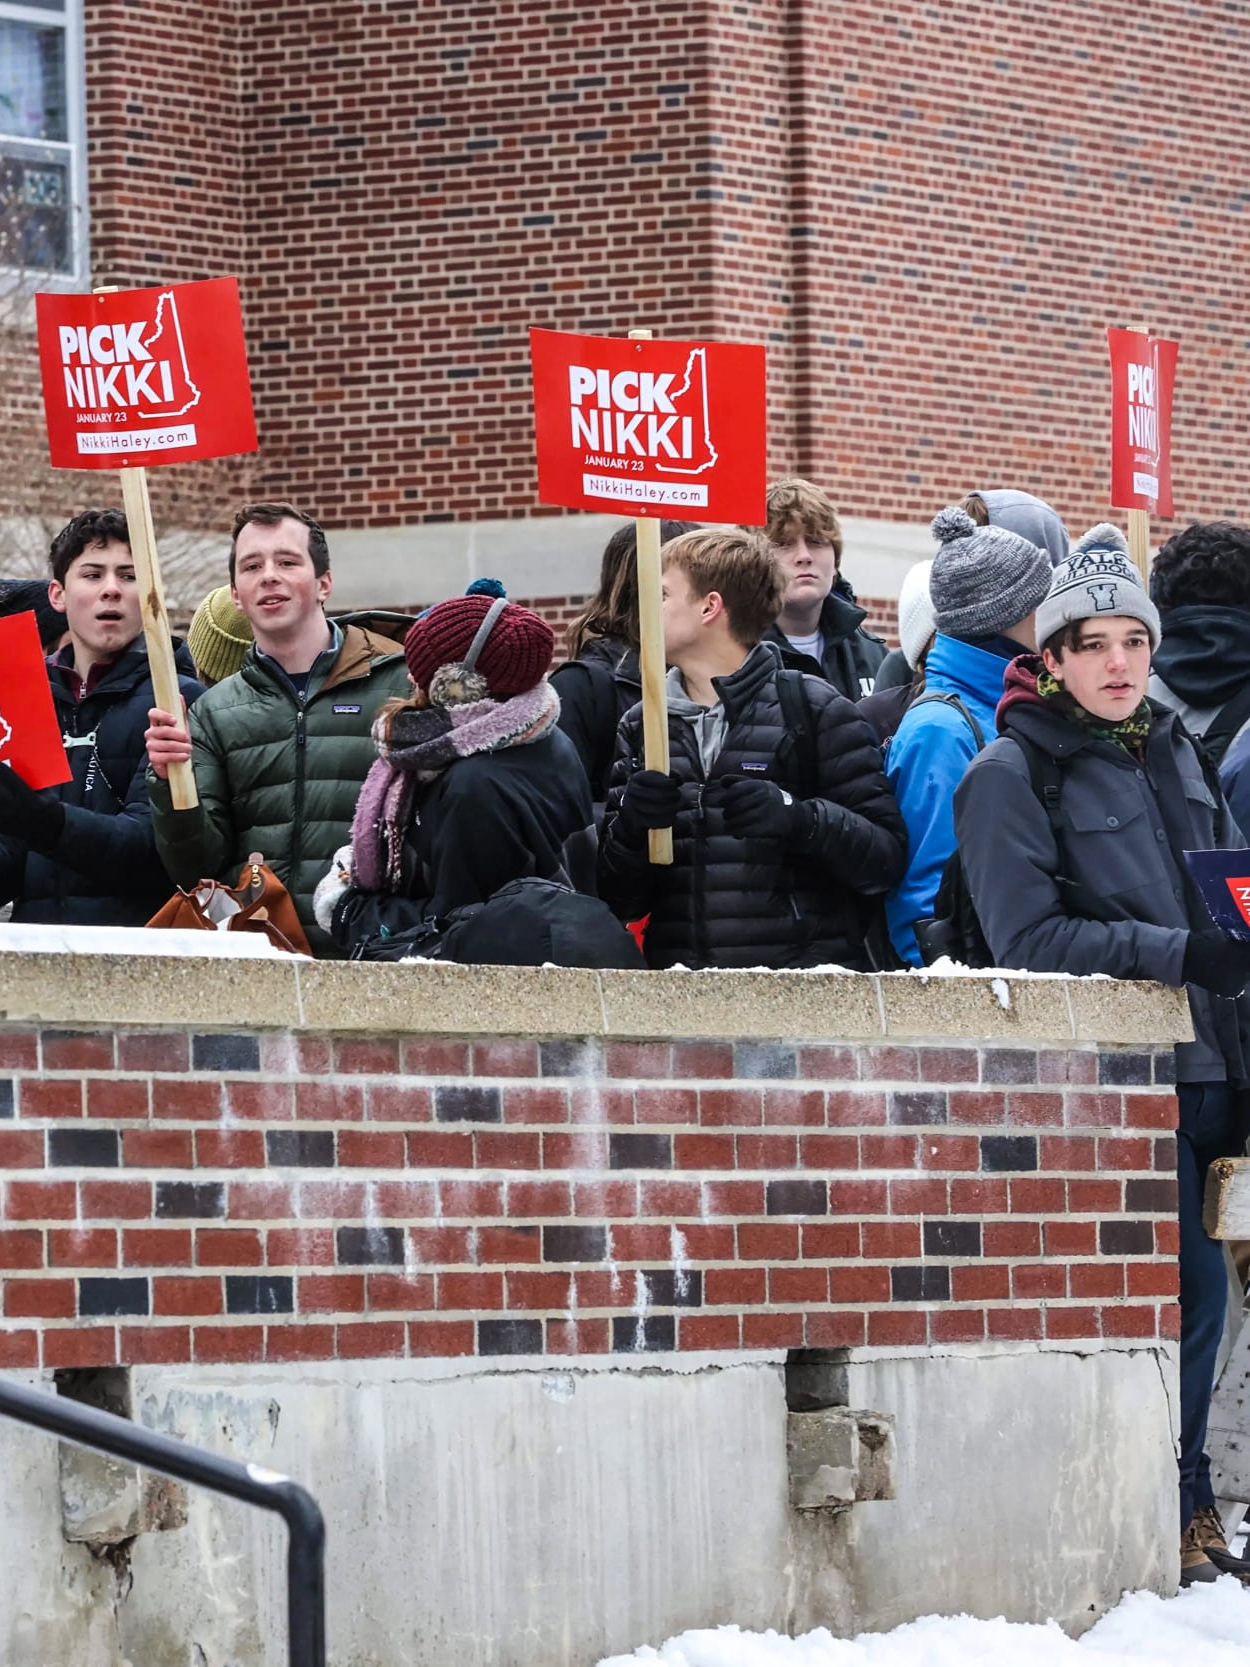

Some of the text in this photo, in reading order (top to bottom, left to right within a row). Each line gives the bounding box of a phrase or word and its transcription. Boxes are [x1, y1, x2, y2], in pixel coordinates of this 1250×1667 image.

[59, 321, 153, 364] PICK
[63, 360, 174, 408] NIKKI
[569, 365, 677, 413] PICK
[76, 412, 127, 423] JANUARY 23
[82, 432, 188, 449] NikkiHaley.com
[571, 406, 692, 459] NIKKI
[584, 455, 644, 471] JANUARY 23
[590, 479, 700, 501] NikkiHaley.com
[1068, 553, 1127, 573] YALE
[1086, 583, 1118, 612] Y
